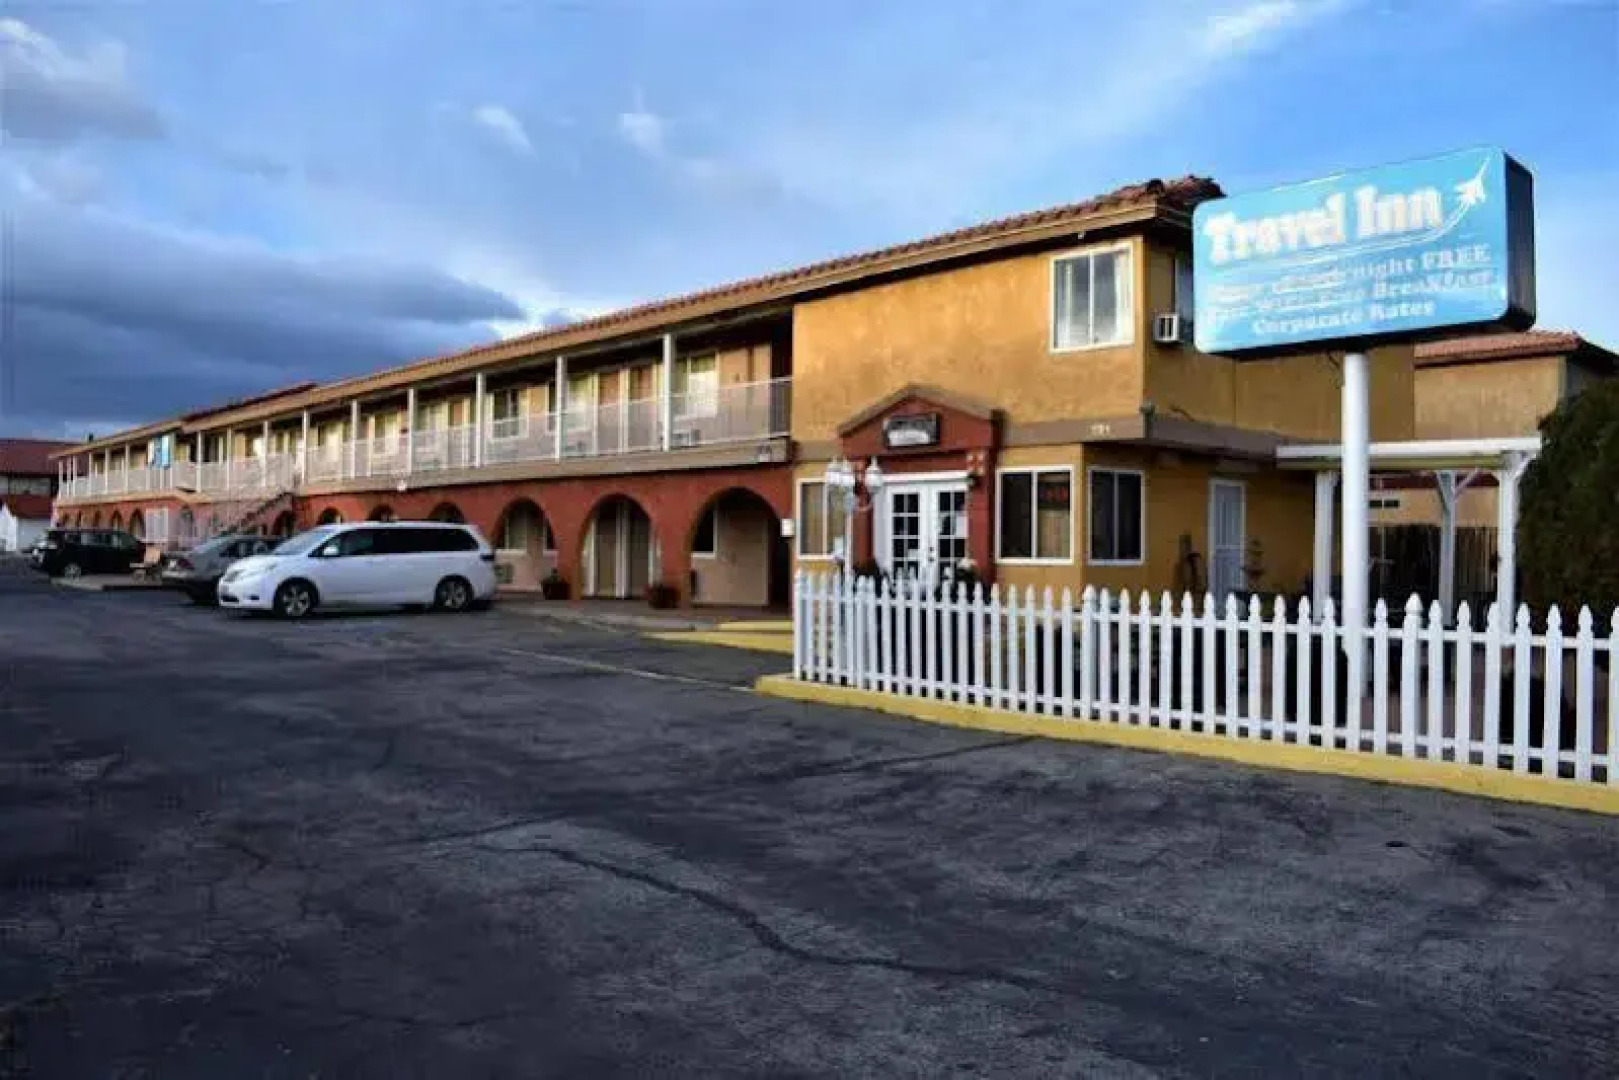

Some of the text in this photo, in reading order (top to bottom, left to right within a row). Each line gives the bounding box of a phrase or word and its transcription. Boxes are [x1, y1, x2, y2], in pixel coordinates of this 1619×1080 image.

[1204, 185, 1443, 264] Travel Inn
[1422, 243, 1491, 270] FREE
[1369, 301, 1436, 322] Rates
